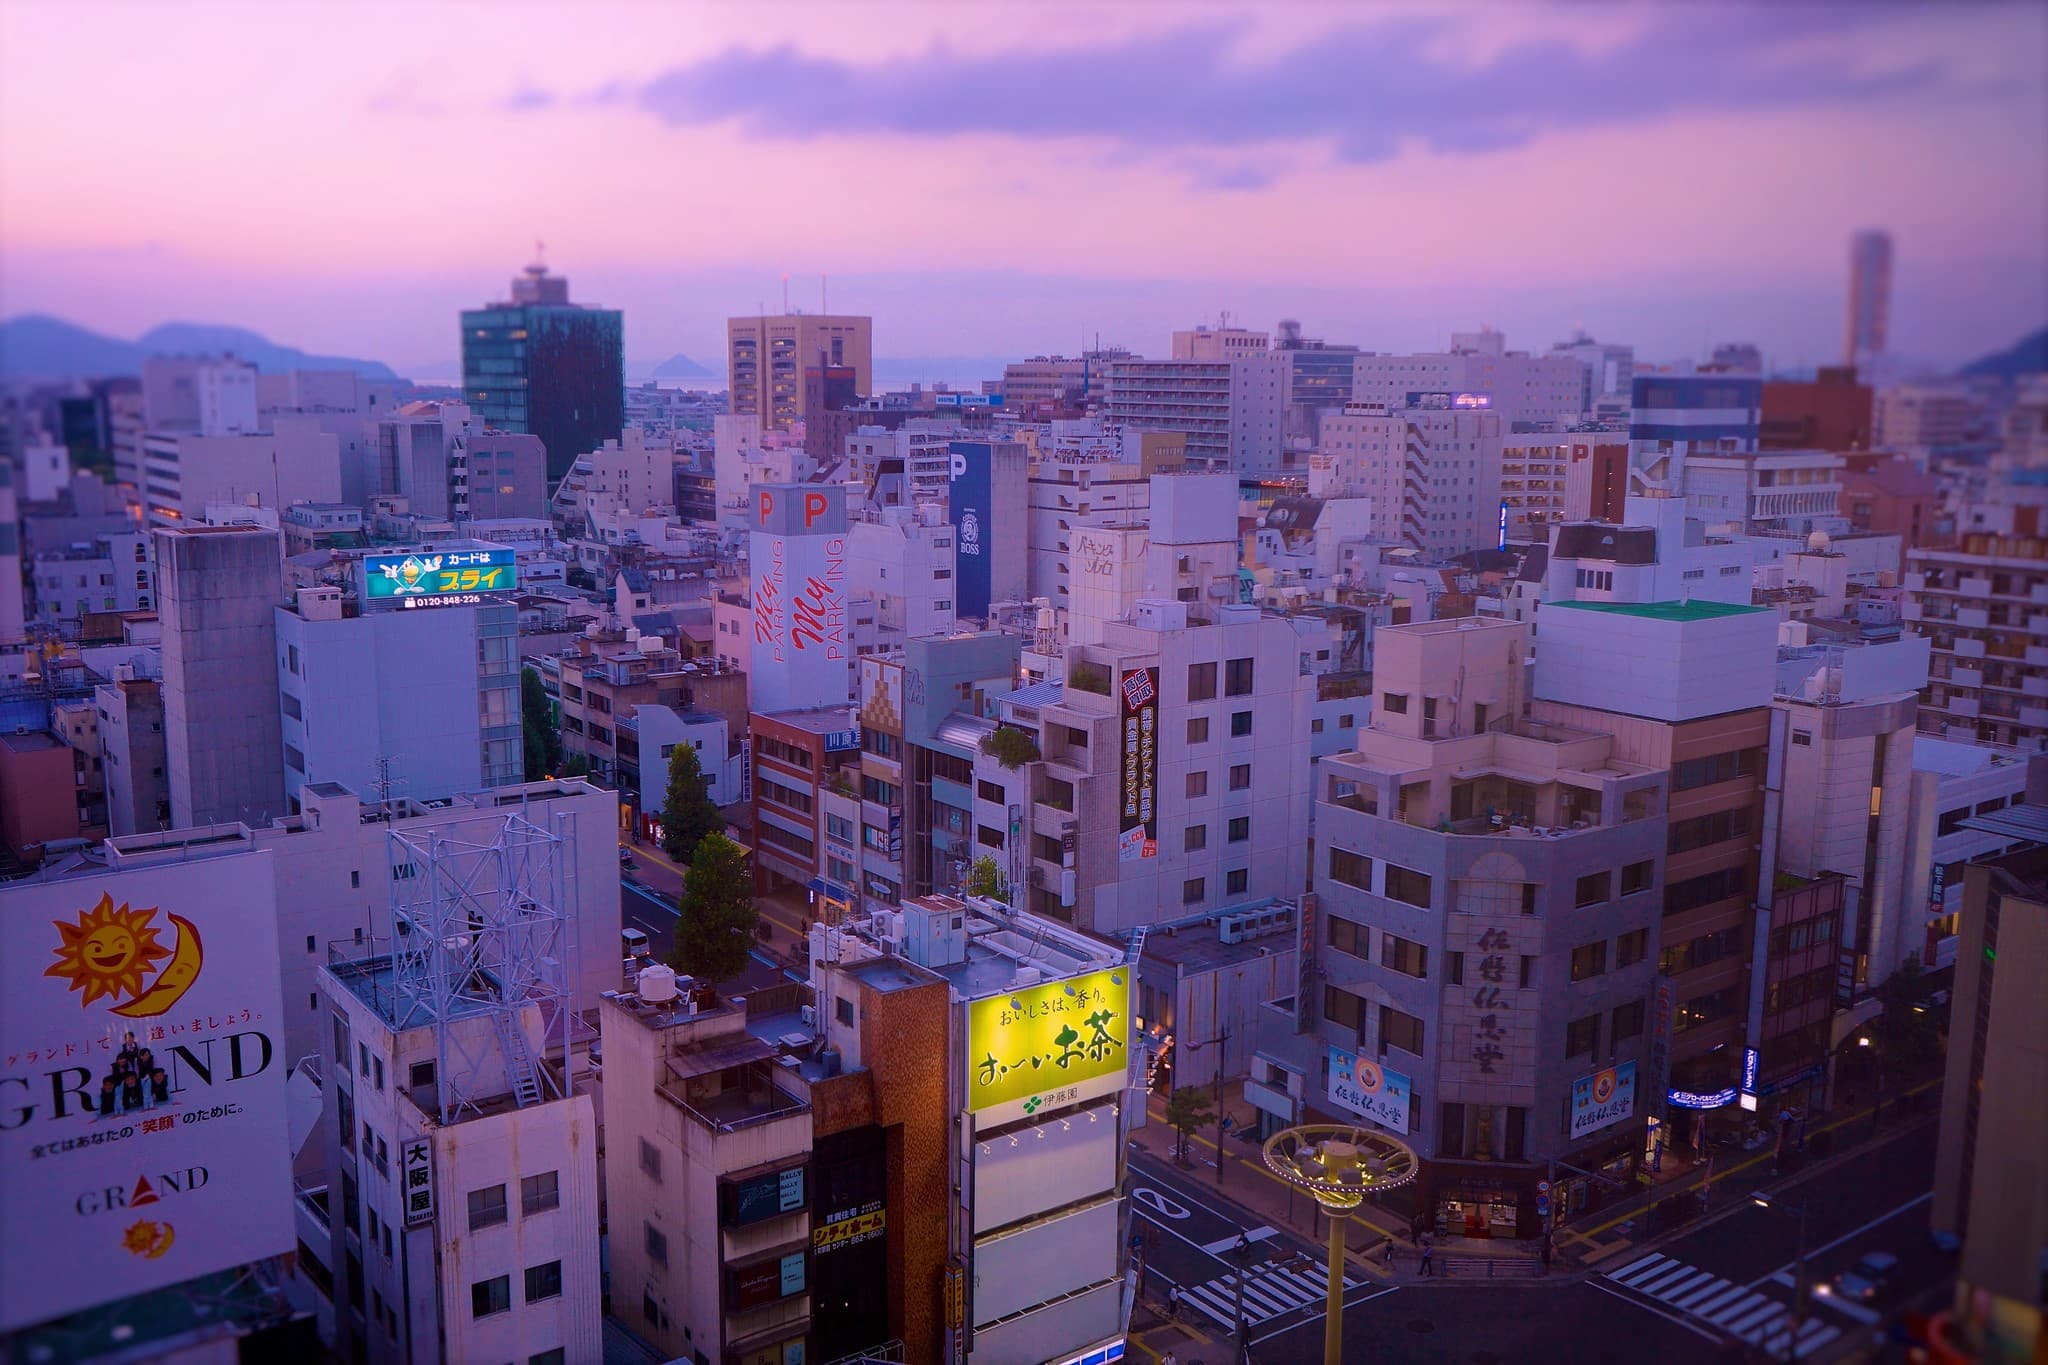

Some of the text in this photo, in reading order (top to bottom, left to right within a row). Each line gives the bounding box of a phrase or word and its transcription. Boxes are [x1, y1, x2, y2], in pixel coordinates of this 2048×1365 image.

[950, 454, 967, 481] P
[760, 492, 774, 525] P
[805, 493, 827, 528] P
[448, 552, 491, 565] カードは
[960, 542, 979, 555] BOSS
[417, 595, 480, 607] 0120-848-226
[755, 540, 784, 663] My PARKING
[791, 538, 845, 662] My PARKING
[1044, 1087, 1078, 1107] 伊藤園
[408, 1144, 431, 1212] 大阪屋
